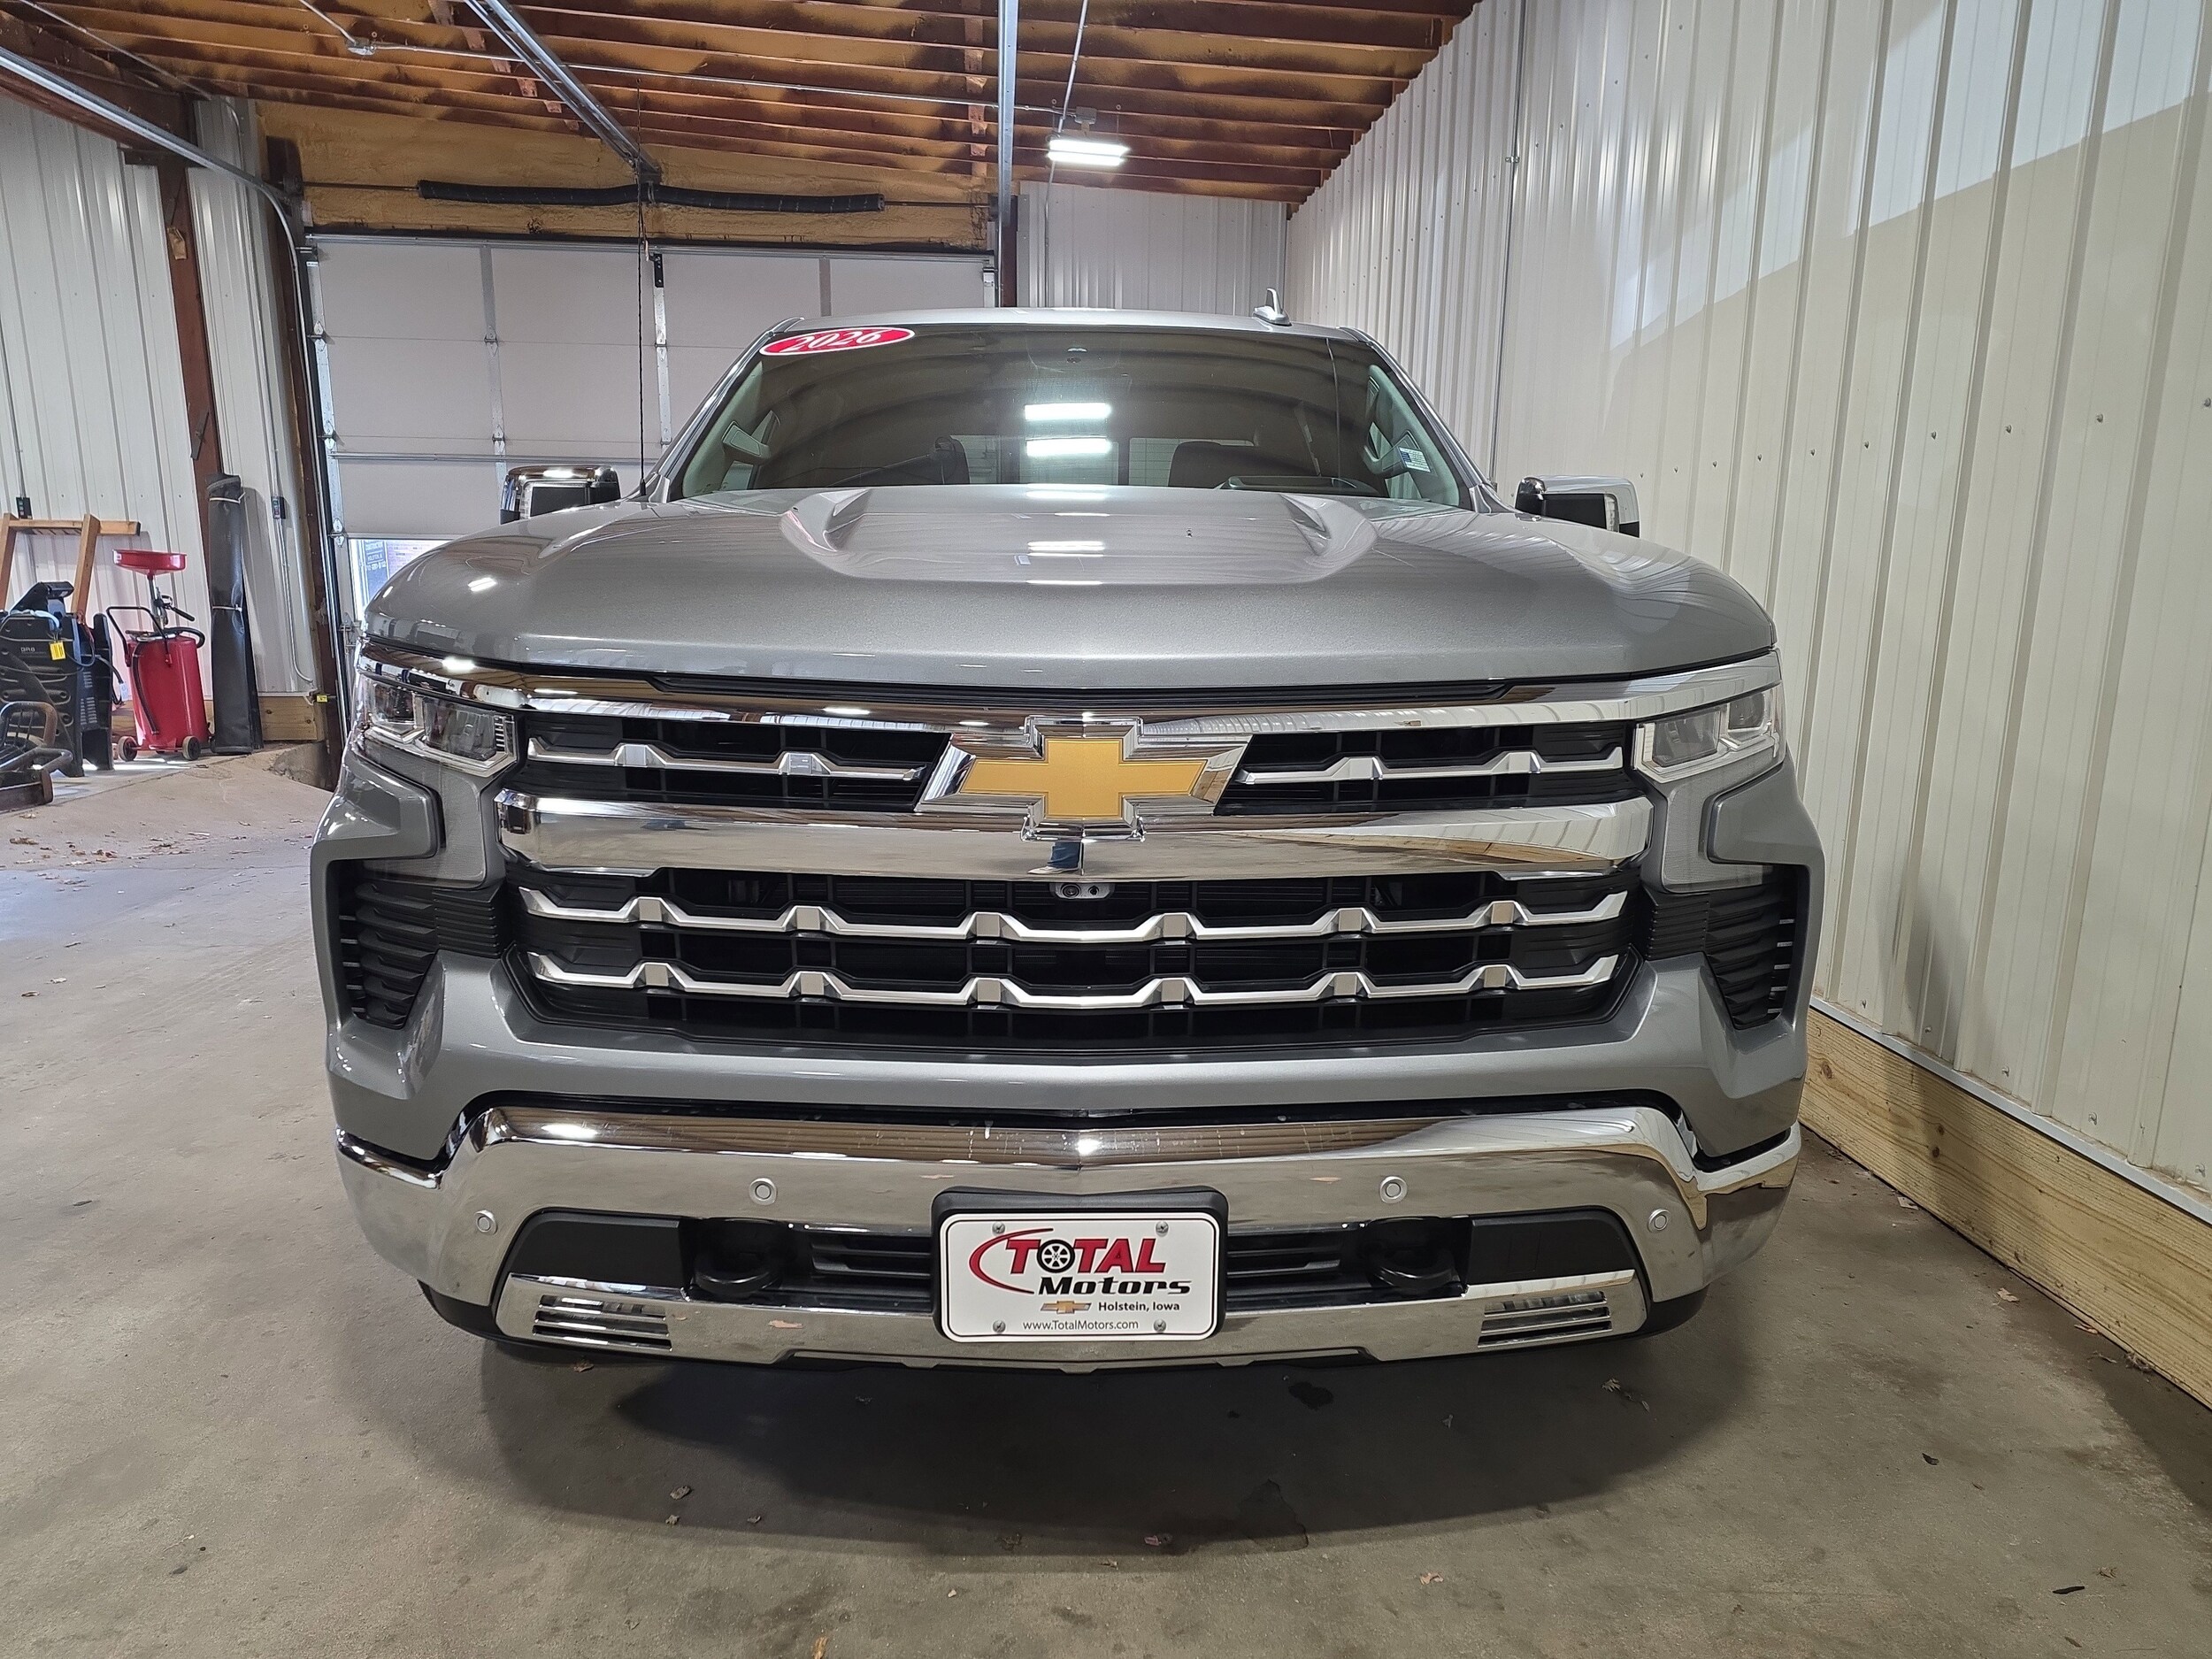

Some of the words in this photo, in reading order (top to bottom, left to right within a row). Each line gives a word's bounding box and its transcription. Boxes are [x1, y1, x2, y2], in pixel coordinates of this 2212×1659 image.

[779, 328, 891, 353] 2026
[1006, 1238, 1167, 1274] TOTAL
[1038, 1276, 1192, 1295] Motors
[1098, 1301, 1149, 1312] Holstein,
[1152, 1302, 1180, 1311] Iowa
[1023, 1319, 1139, 1331] www.TotalMotors.com
